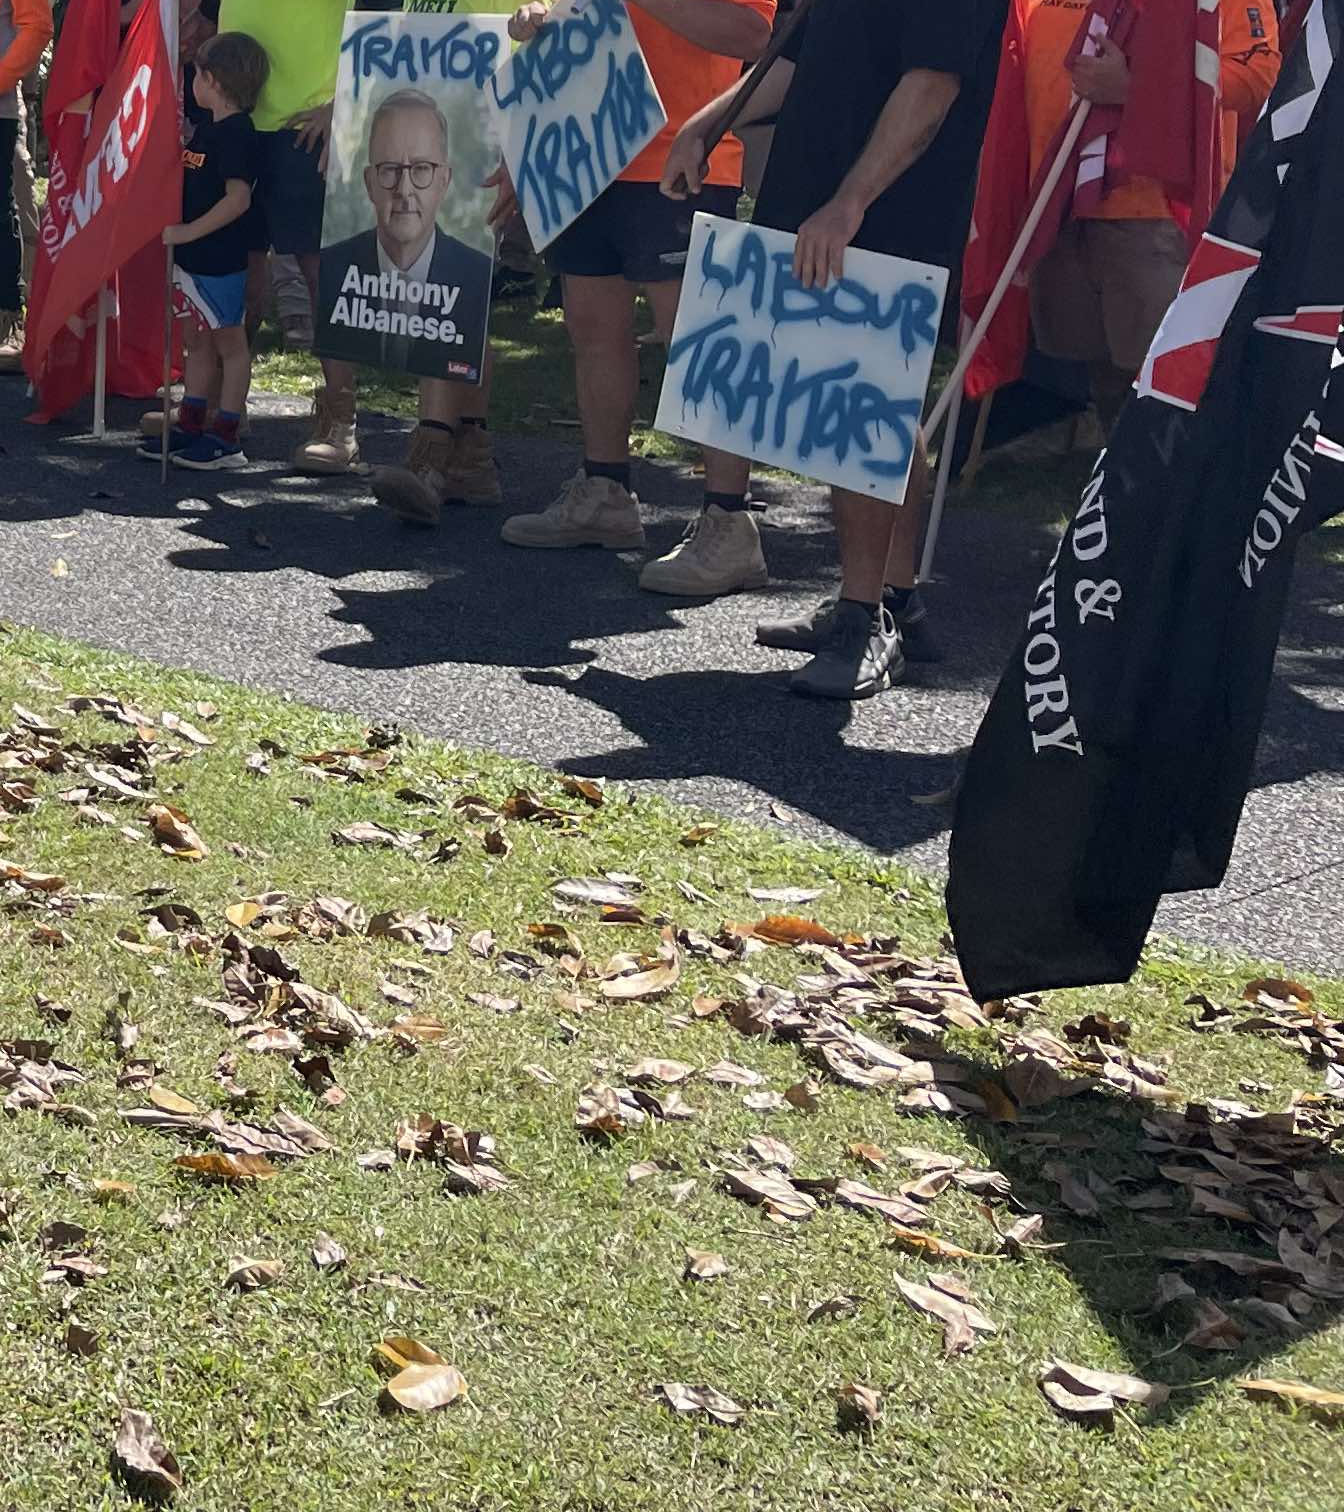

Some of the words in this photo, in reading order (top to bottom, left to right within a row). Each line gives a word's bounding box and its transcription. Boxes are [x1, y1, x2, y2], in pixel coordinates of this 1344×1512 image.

[340, 16, 501, 100] TRAITOR
[329, 295, 465, 345] Albanese.
[340, 264, 462, 315] Anthony
[699, 230, 939, 355] LABOUR
[667, 314, 923, 478] TRAITORS
